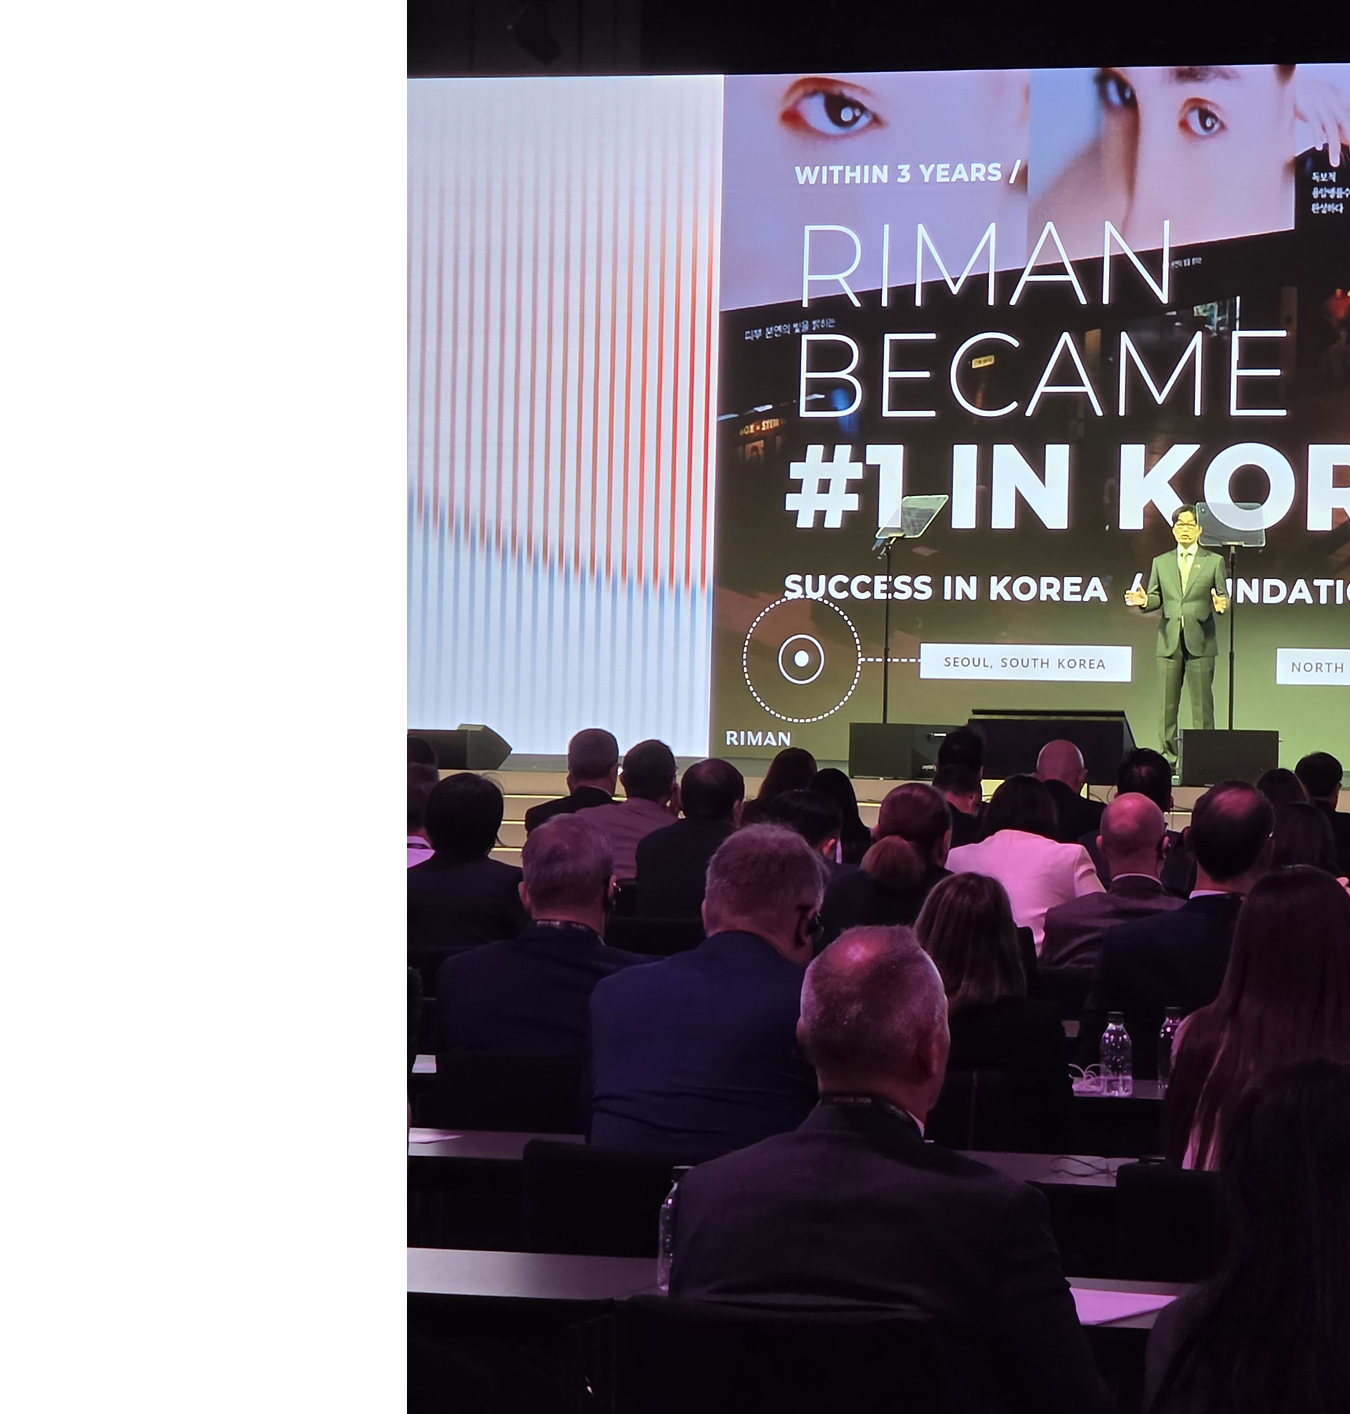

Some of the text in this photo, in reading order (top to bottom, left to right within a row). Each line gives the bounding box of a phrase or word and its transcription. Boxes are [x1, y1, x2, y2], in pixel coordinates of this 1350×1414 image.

[794, 159, 1022, 185] WITHIN 3 YEARS /
[801, 219, 1173, 308] RIMAN
[799, 331, 1288, 417] BECAME
[785, 444, 905, 529] #1
[950, 444, 1070, 530] IN
[783, 574, 933, 601] SUCCESS
[943, 575, 978, 601] IN
[989, 576, 1108, 602] KOREA
[944, 656, 1106, 671] SEOUL, SOUTH KOREA
[1291, 661, 1345, 674] NORTH
[725, 730, 792, 747] RIMAN
